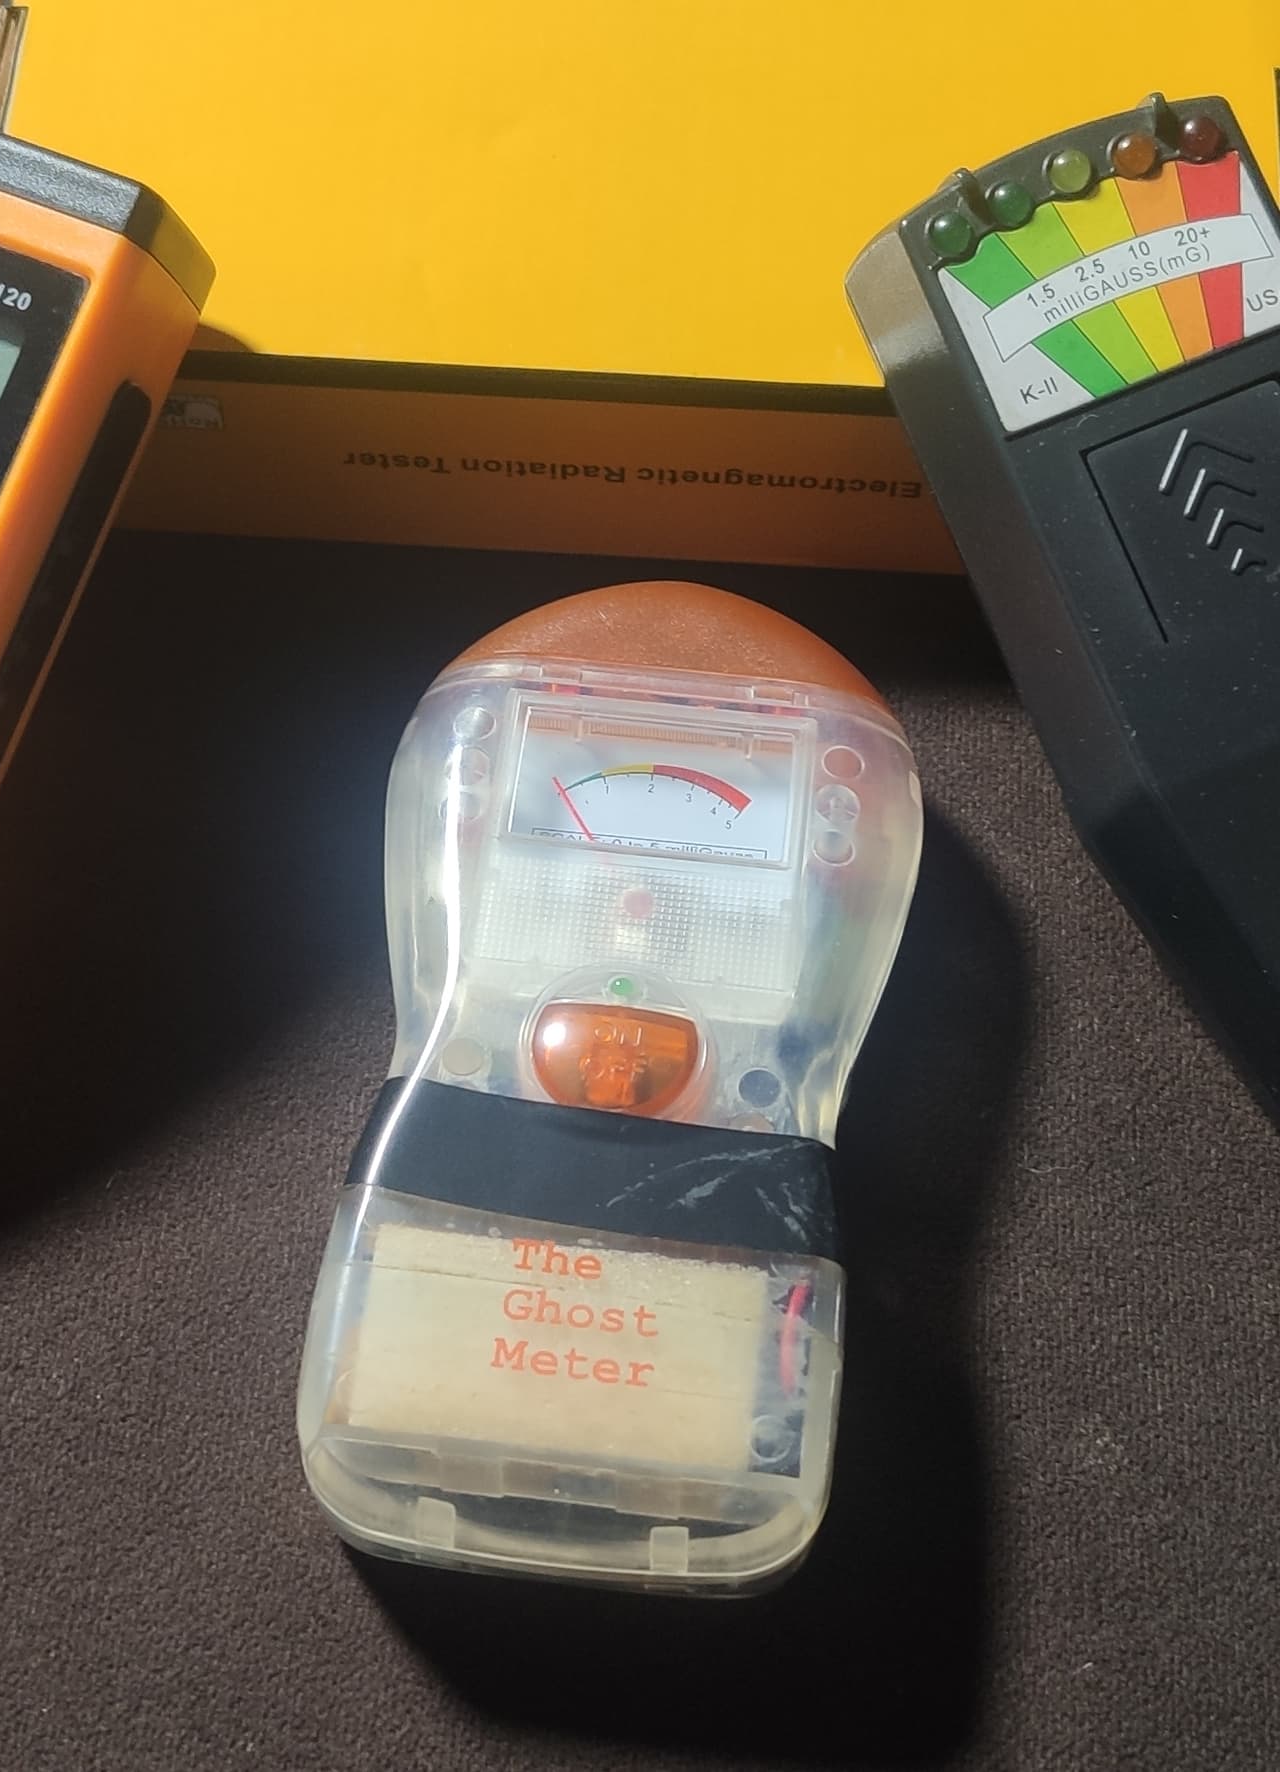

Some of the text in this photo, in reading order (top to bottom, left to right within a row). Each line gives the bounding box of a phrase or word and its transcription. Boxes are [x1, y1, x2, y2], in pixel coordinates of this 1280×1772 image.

[1027, 226, 1211, 308] 1.5 2.5 10 20+
[343, 452, 923, 498] Electromagnetic Radiation Tester
[594, 1021, 642, 1046] ON
[512, 1238, 603, 1280] The
[503, 1289, 658, 1337] Ghost
[490, 1337, 655, 1388] Meter
